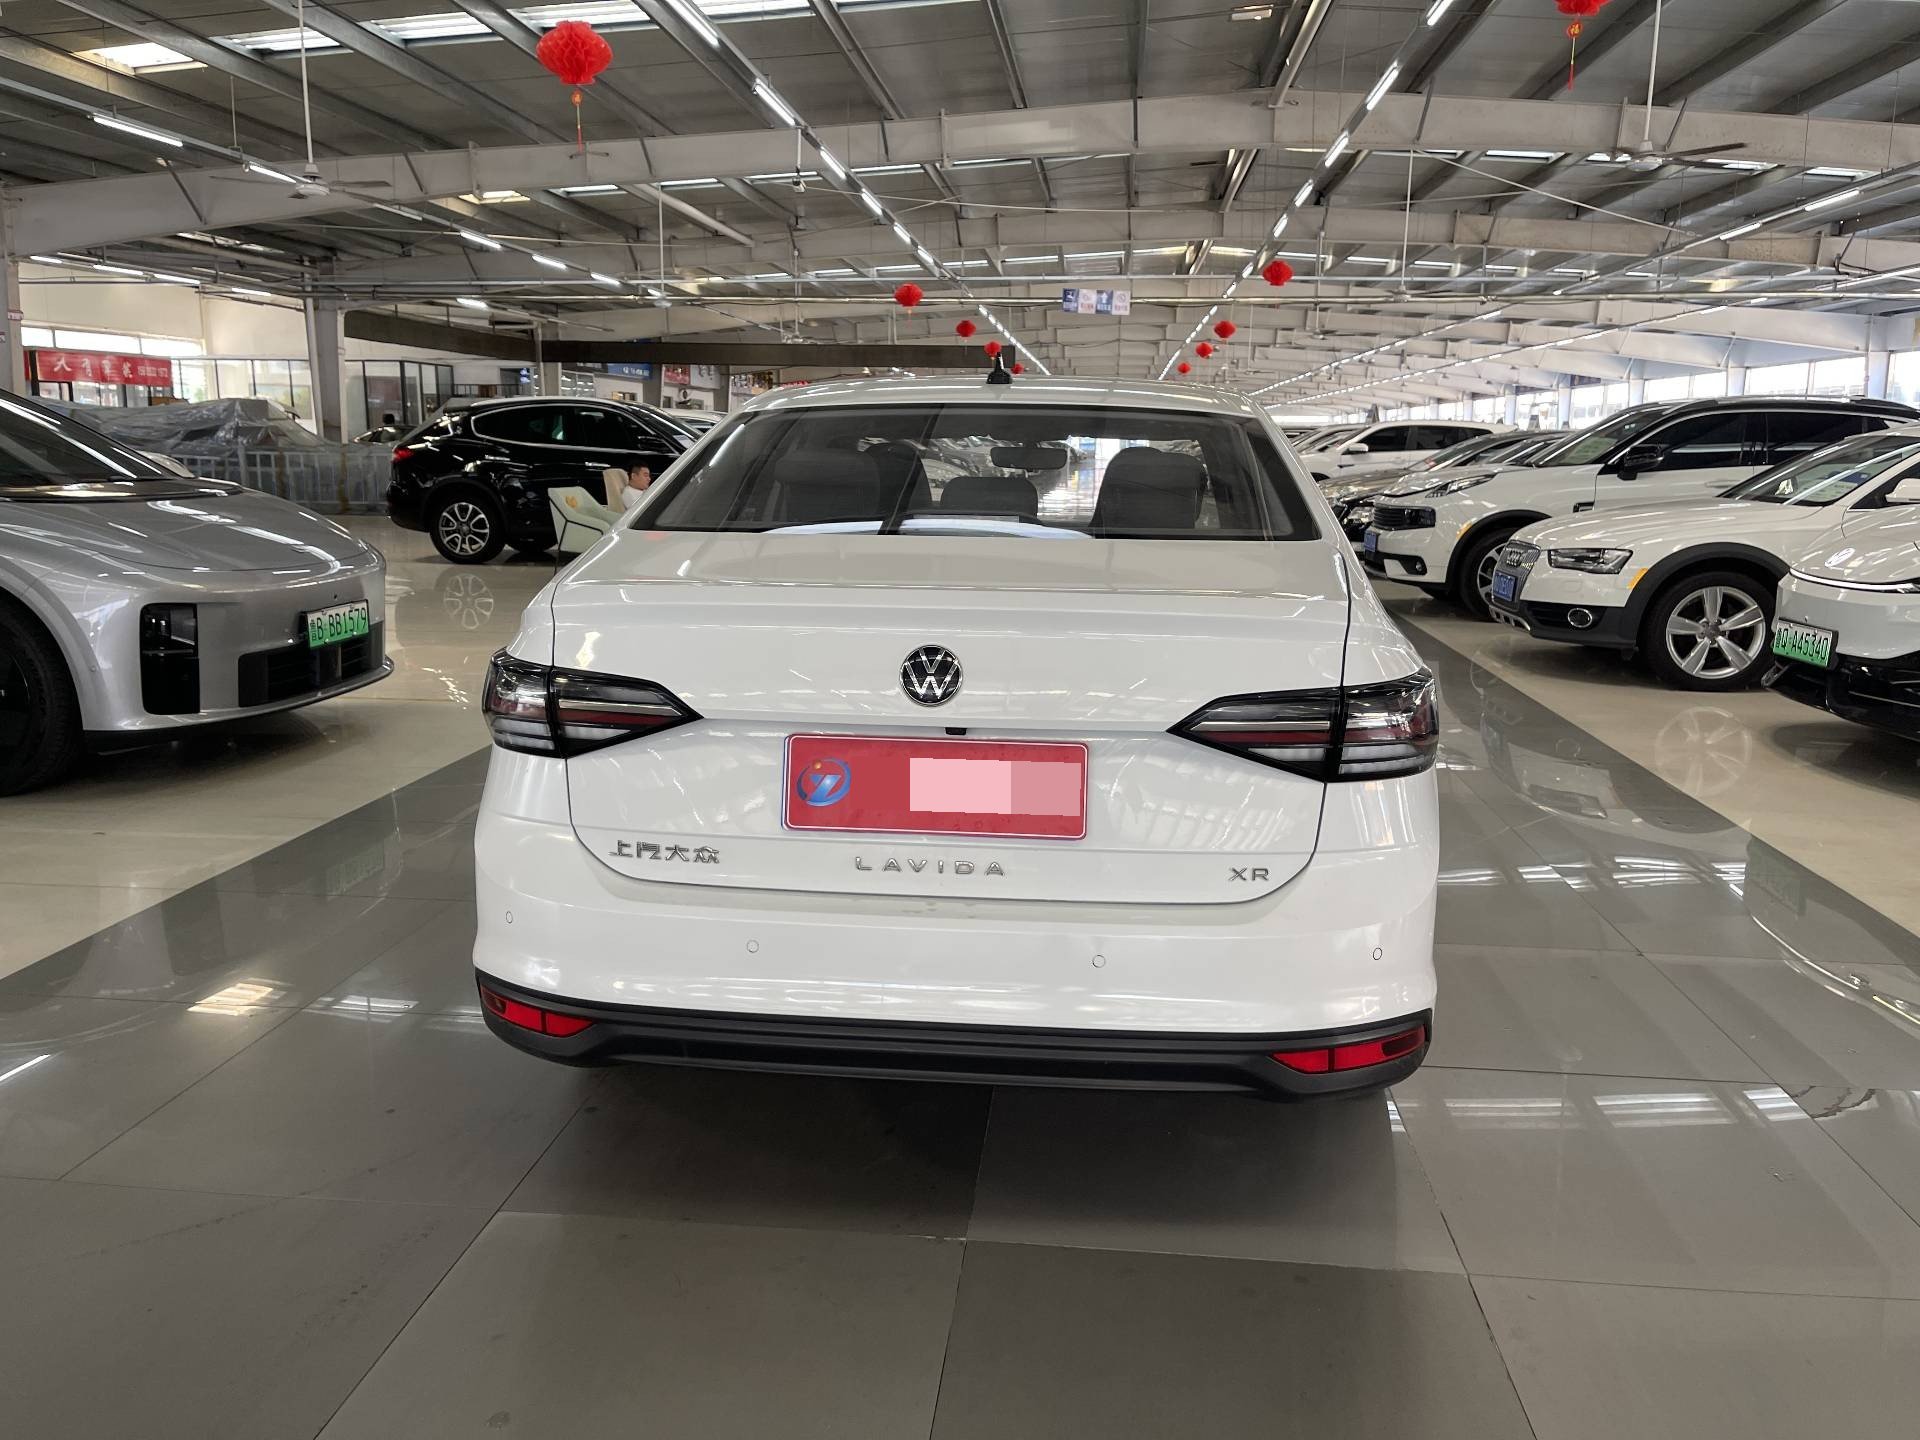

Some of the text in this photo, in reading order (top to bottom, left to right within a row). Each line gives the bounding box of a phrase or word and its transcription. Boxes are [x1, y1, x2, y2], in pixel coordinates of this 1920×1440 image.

[328, 607, 367, 637] BB1579
[1791, 630, 1829, 660] A45340
[608, 840, 719, 864] 上汽大众
[855, 856, 1005, 876] LAVIDA
[1228, 868, 1270, 881] XR
